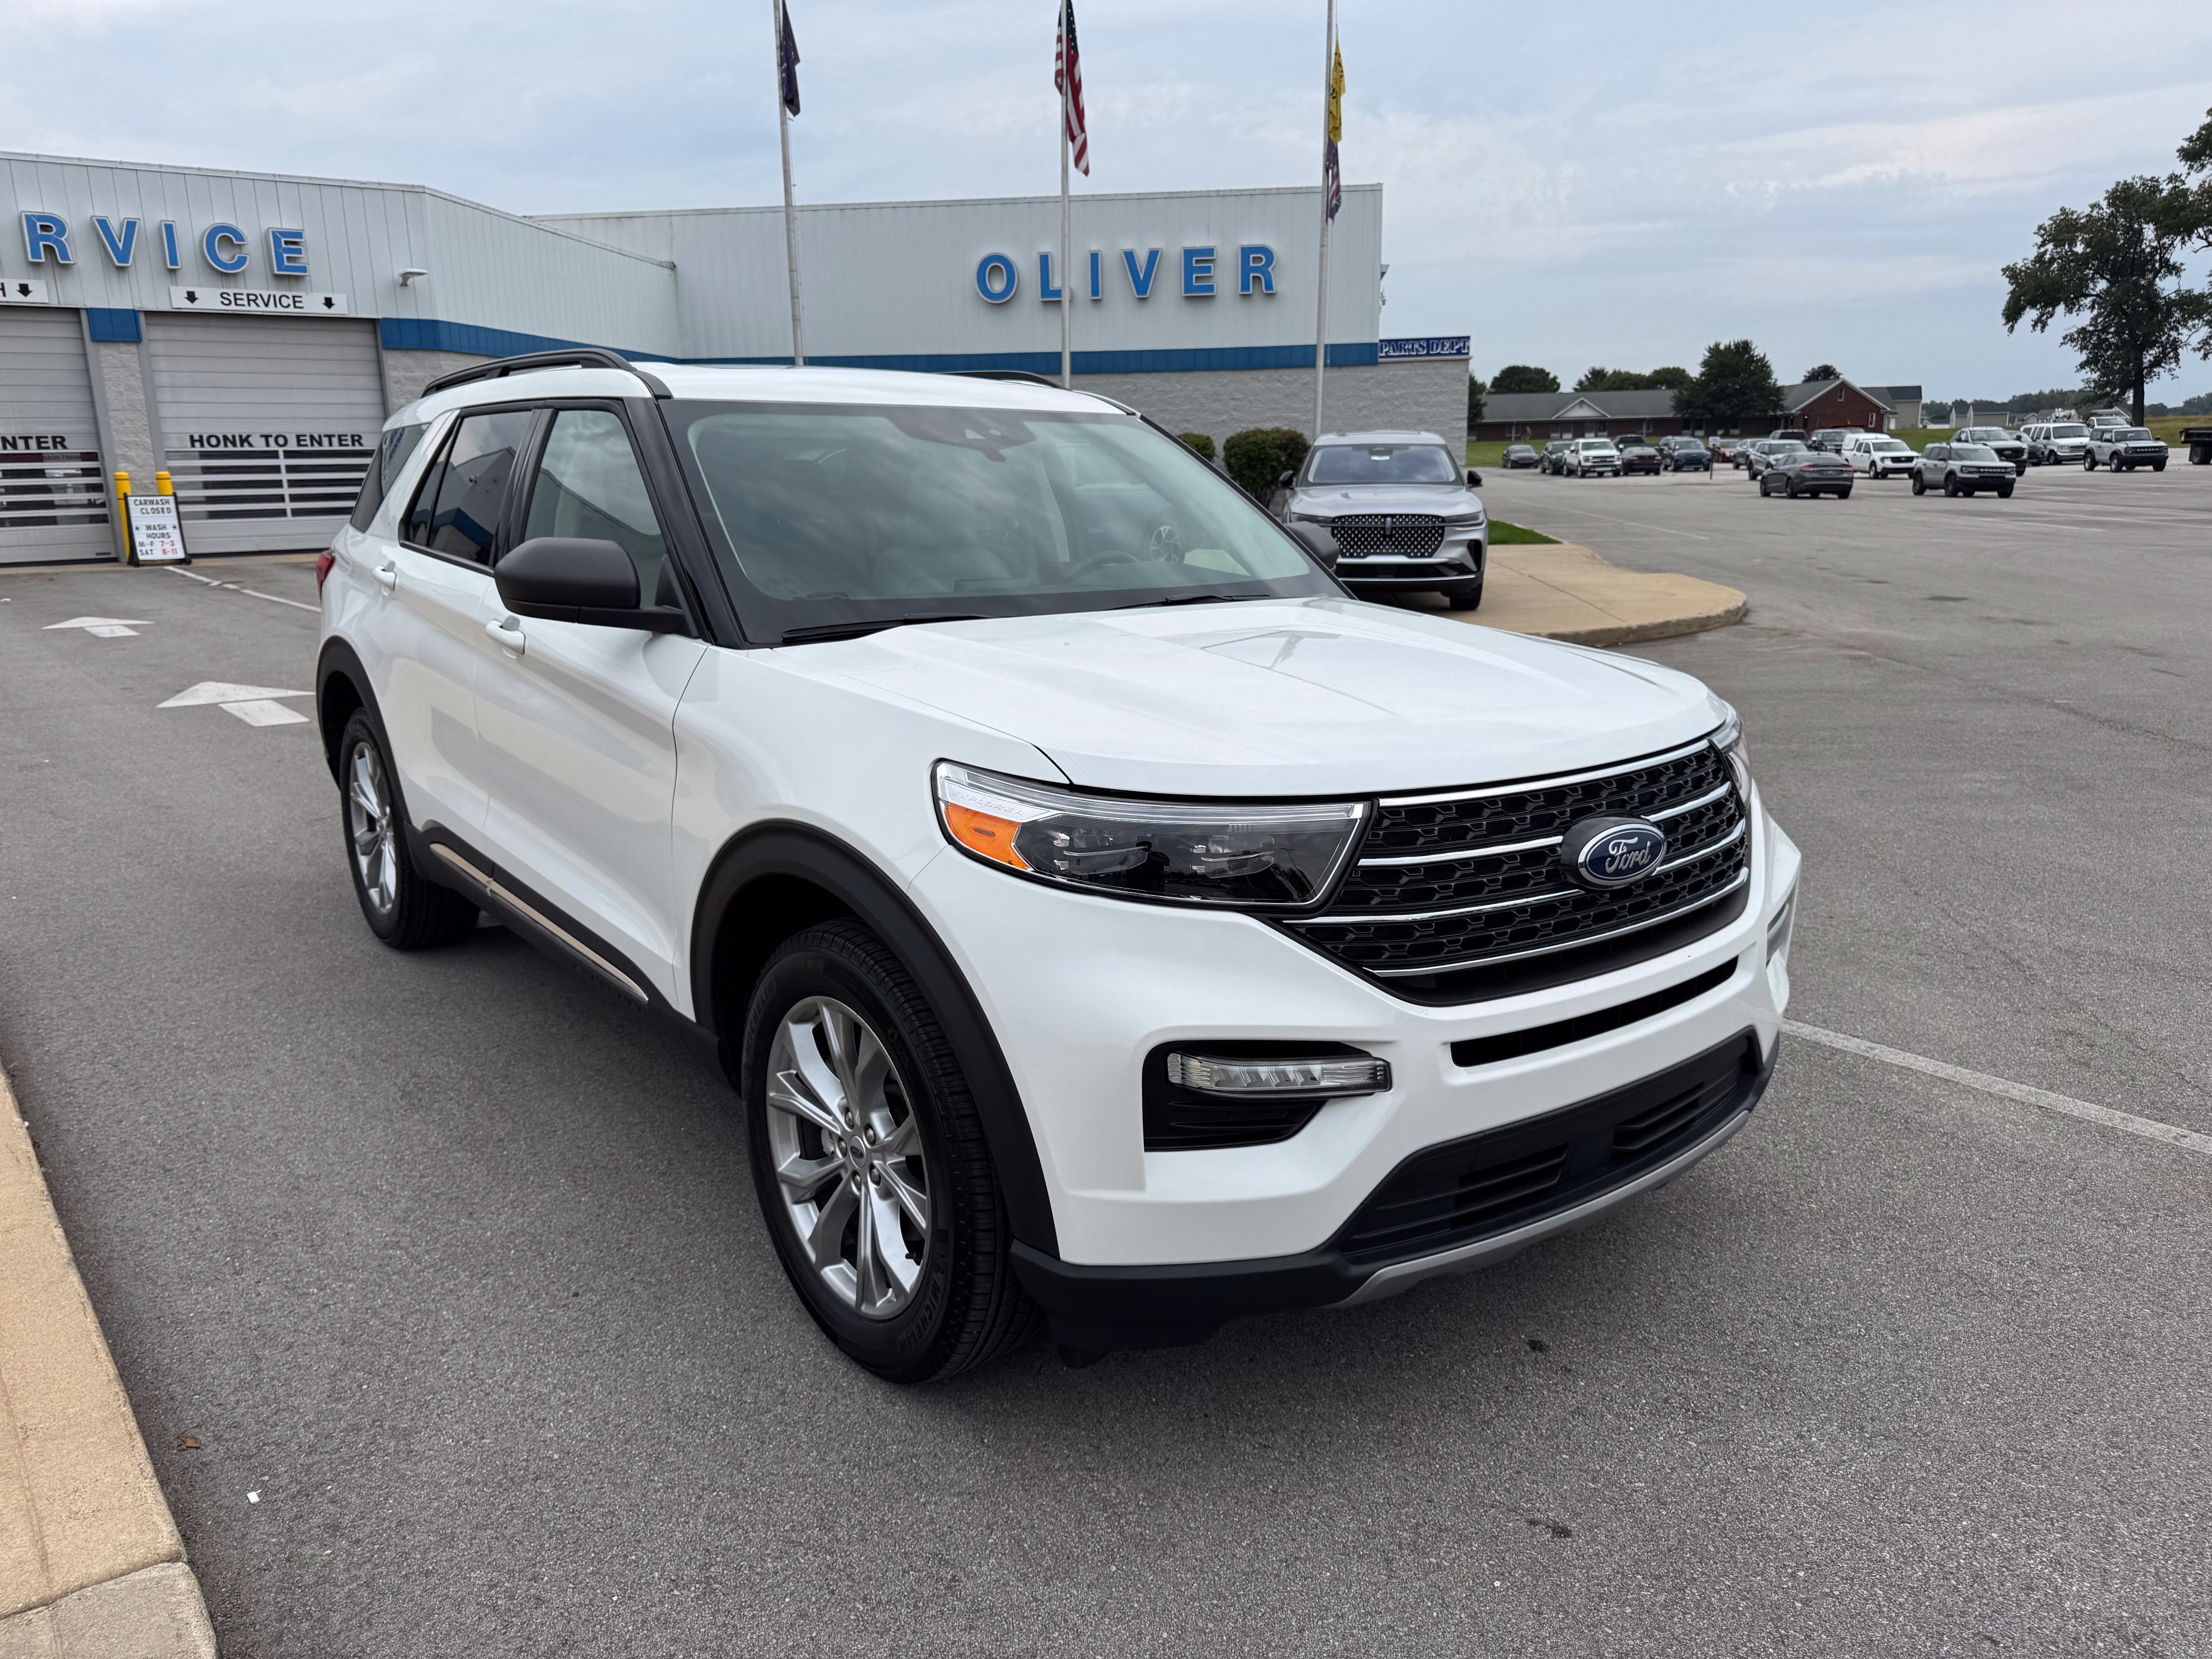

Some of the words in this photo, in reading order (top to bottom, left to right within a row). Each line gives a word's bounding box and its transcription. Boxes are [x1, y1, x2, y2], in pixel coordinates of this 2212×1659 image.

[21, 211, 309, 276] RVICE
[975, 244, 1276, 303] OLIVER
[220, 292, 304, 309] SERVICE
[1378, 342, 1427, 356] PARTS
[0, 436, 68, 450] NTER
[189, 435, 254, 448] HONK
[260, 435, 288, 447] TO
[295, 434, 364, 447] ENTER
[952, 792, 1025, 815] EXPLORER
[1605, 836, 1650, 873] Ford
[898, 1278, 941, 1353] MICHELIN
